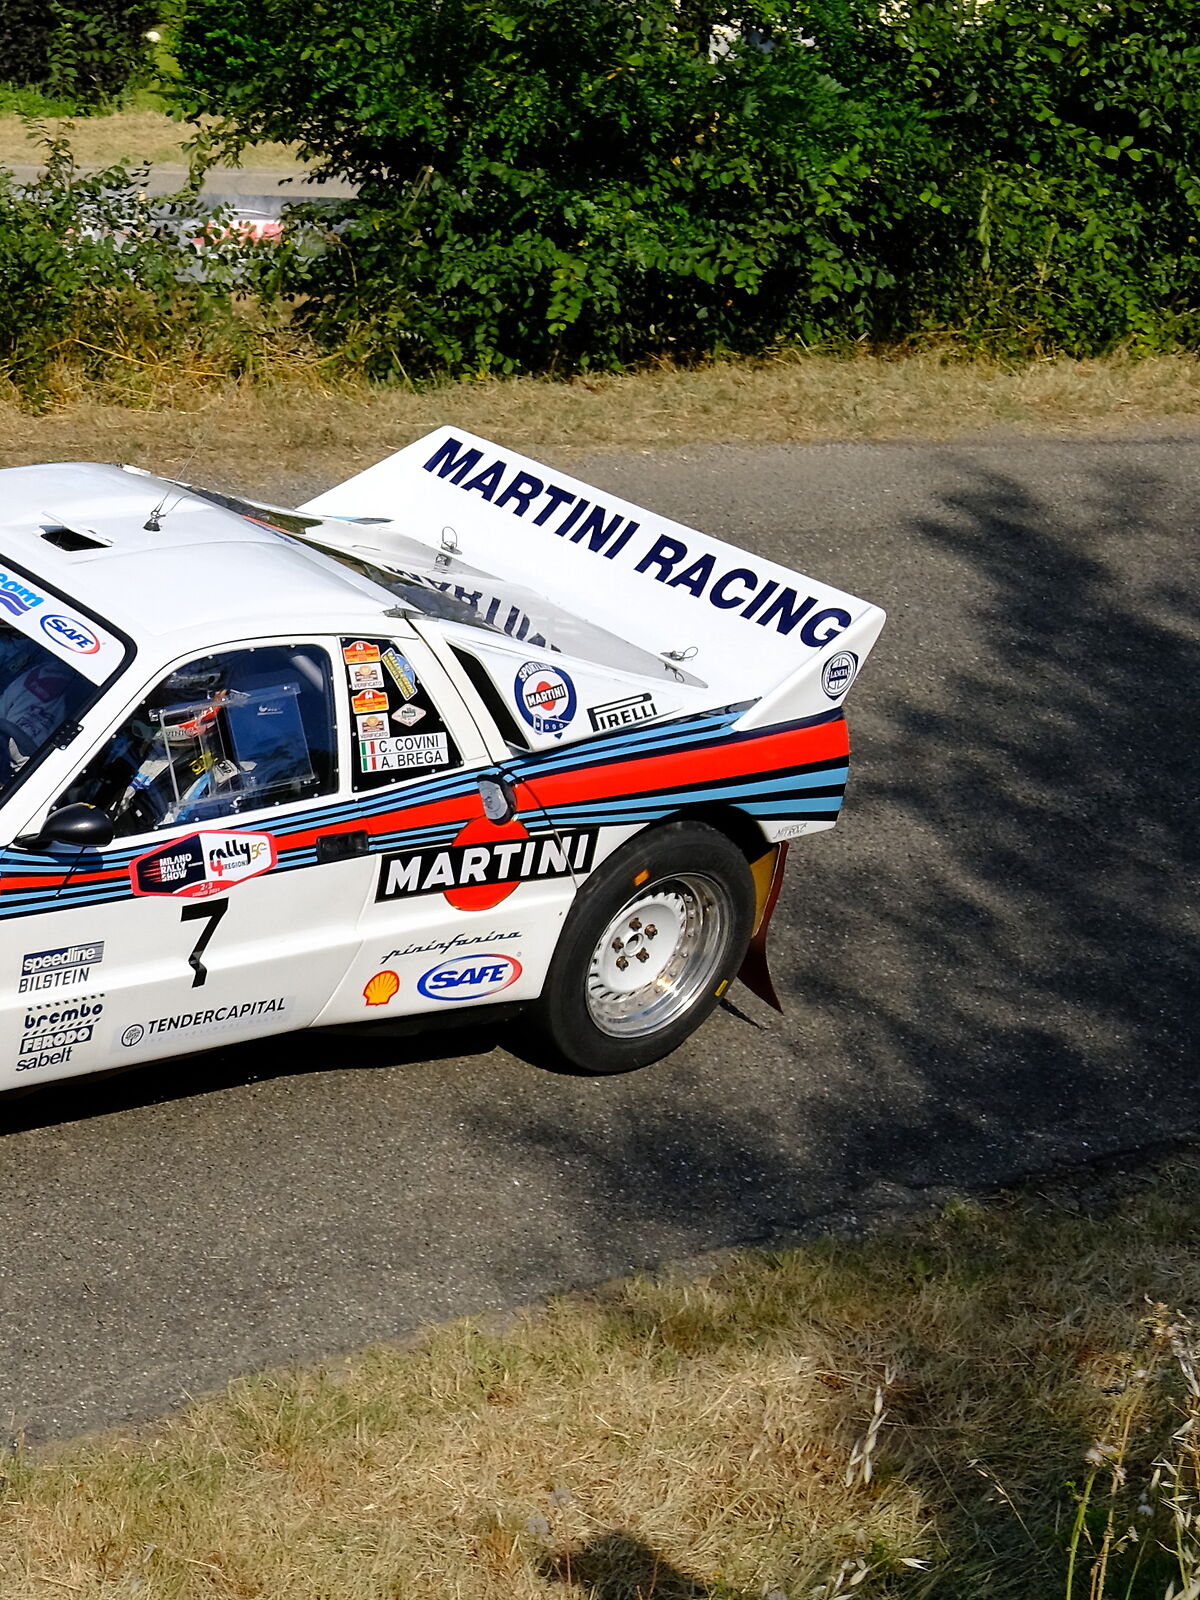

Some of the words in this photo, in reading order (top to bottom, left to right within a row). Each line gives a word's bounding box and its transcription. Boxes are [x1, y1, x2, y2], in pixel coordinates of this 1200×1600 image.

[422, 437, 641, 560] MARTINI
[634, 534, 853, 648] RACING
[47, 618, 94, 648] SAFE
[527, 685, 565, 706] MARTINI
[587, 692, 658, 732] PIRELLI
[379, 741, 392, 753] C.
[395, 735, 439, 751] COVINI
[381, 757, 393, 769] A.
[398, 752, 443, 767] BREGA
[160, 854, 192, 867] MILANO
[209, 839, 251, 865] rally
[385, 834, 590, 895] MARTINI
[160, 862, 186, 874] RALLY
[161, 870, 187, 882] SHOW
[180, 897, 230, 989] 7
[381, 931, 522, 964] pininfarina
[23, 946, 95, 972] speedline
[18, 967, 90, 994] BILSTEIN
[429, 963, 509, 989] SAFE
[25, 1004, 103, 1029] brembo
[149, 997, 285, 1034] TENDERCAPITAL
[22, 1029, 90, 1053] FERODO
[16, 1047, 72, 1072] sabelt
